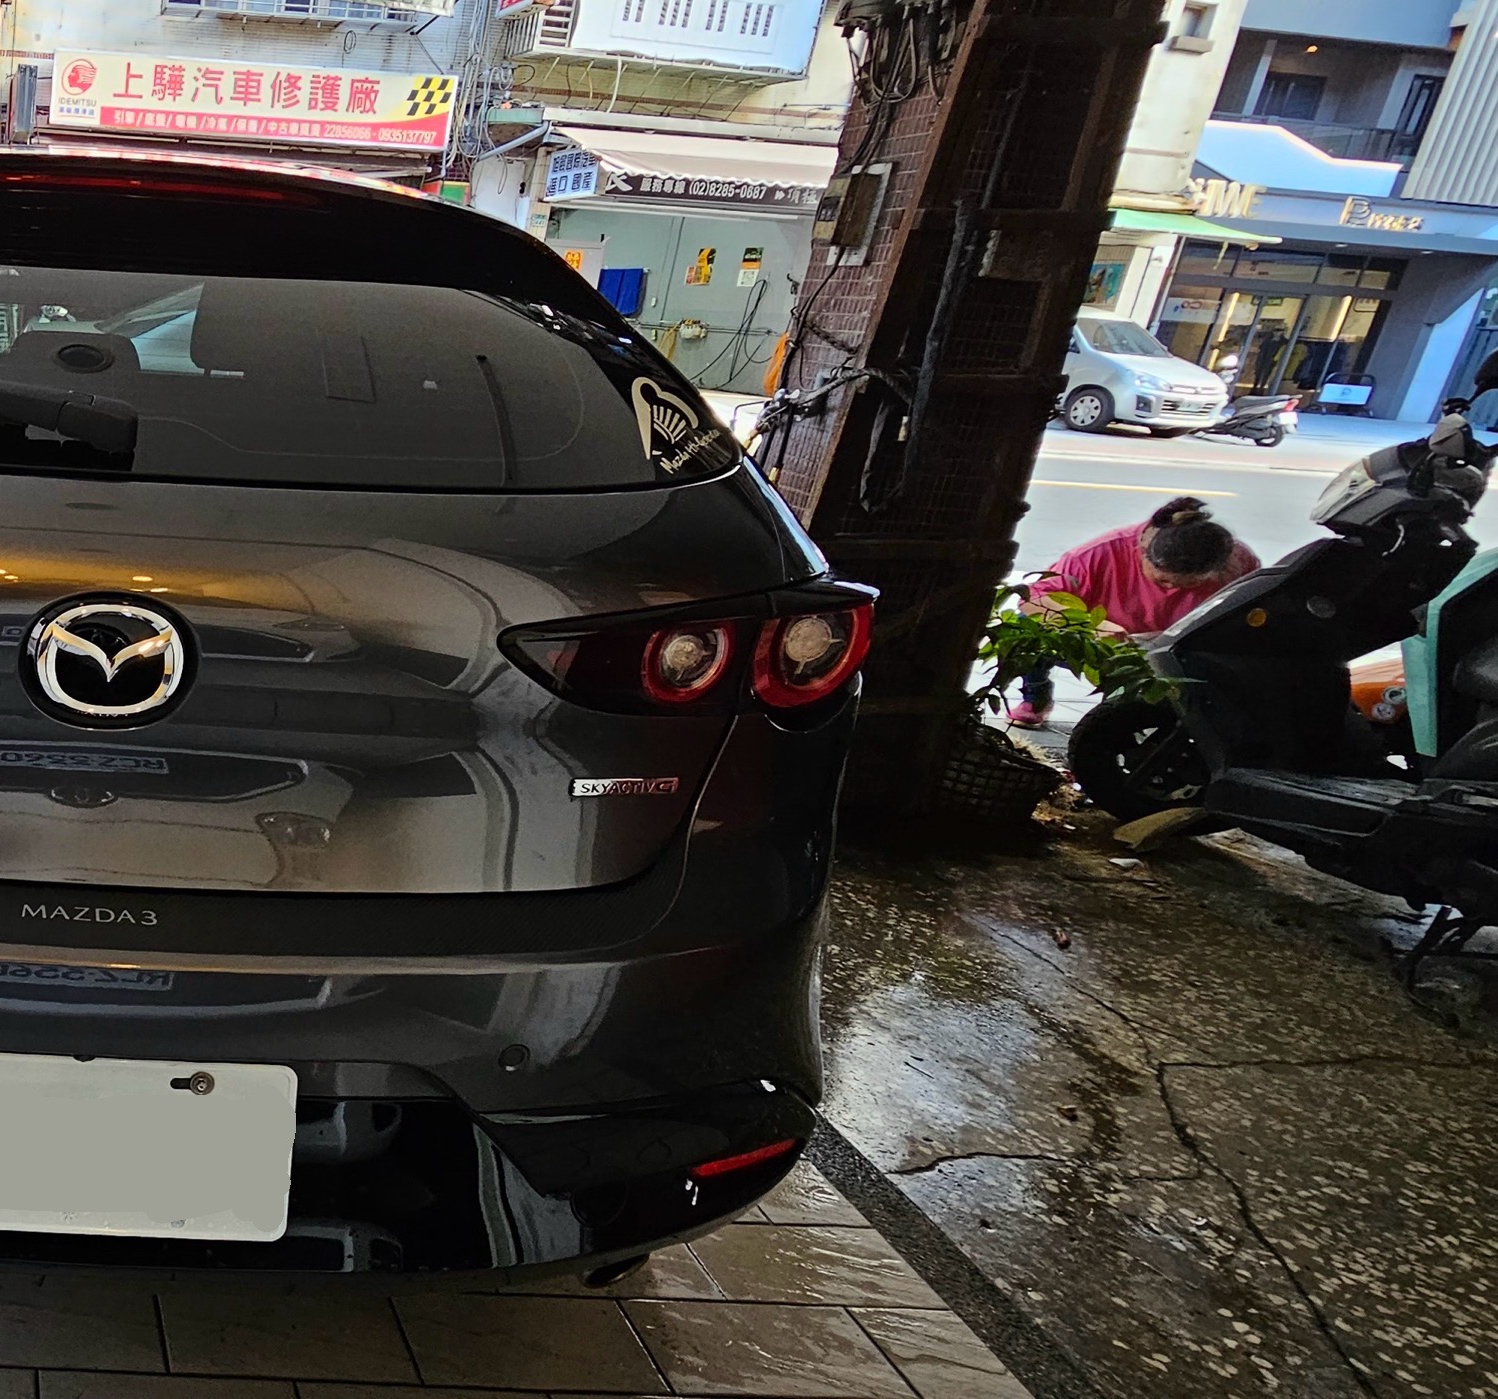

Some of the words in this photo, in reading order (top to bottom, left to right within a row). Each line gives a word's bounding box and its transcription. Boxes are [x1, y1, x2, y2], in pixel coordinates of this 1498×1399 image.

[113, 62, 381, 114] 上驊汽車修護廠
[58, 96, 97, 107] IDEMITSU
[640, 177, 686, 194] 服務專線
[689, 179, 767, 200] (02)8285-0687
[21, 903, 158, 926] MAZDA3
